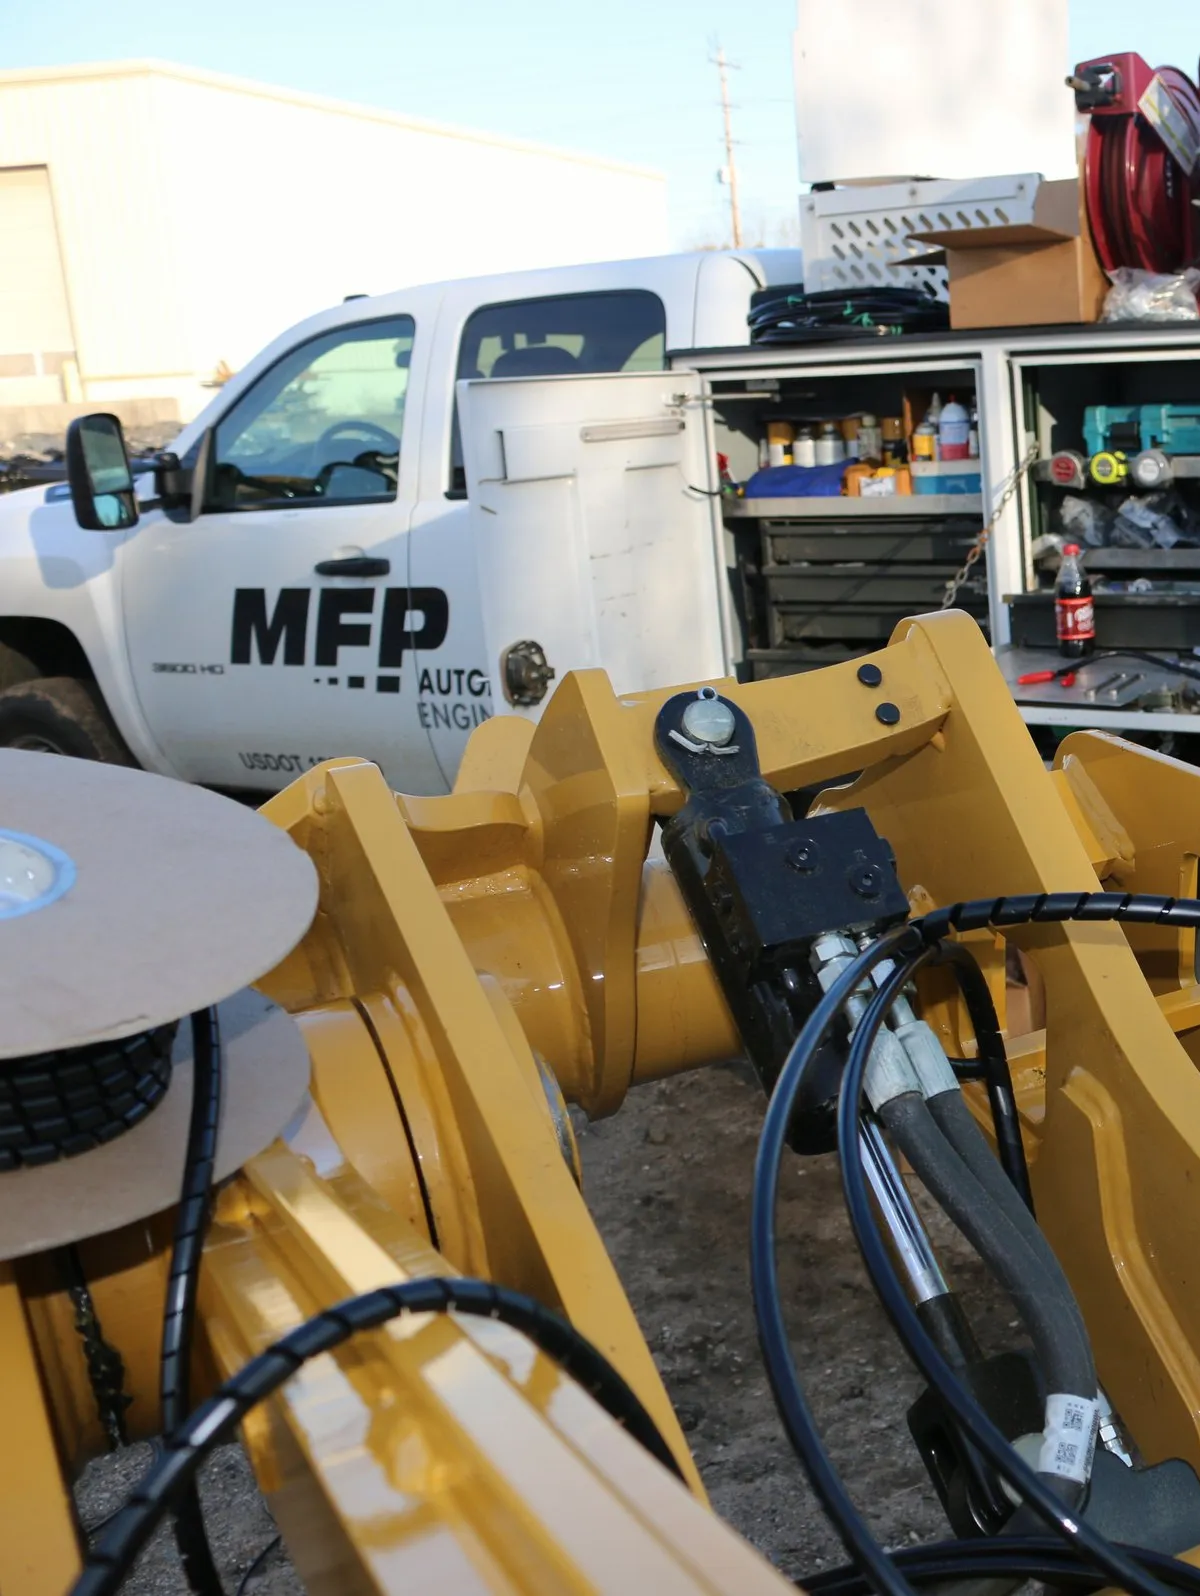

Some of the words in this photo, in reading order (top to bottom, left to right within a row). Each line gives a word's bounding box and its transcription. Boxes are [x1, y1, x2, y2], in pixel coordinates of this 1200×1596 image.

[230, 586, 449, 668] MFP
[419, 668, 491, 697] AUTO
[238, 752, 305, 773] USDOT
